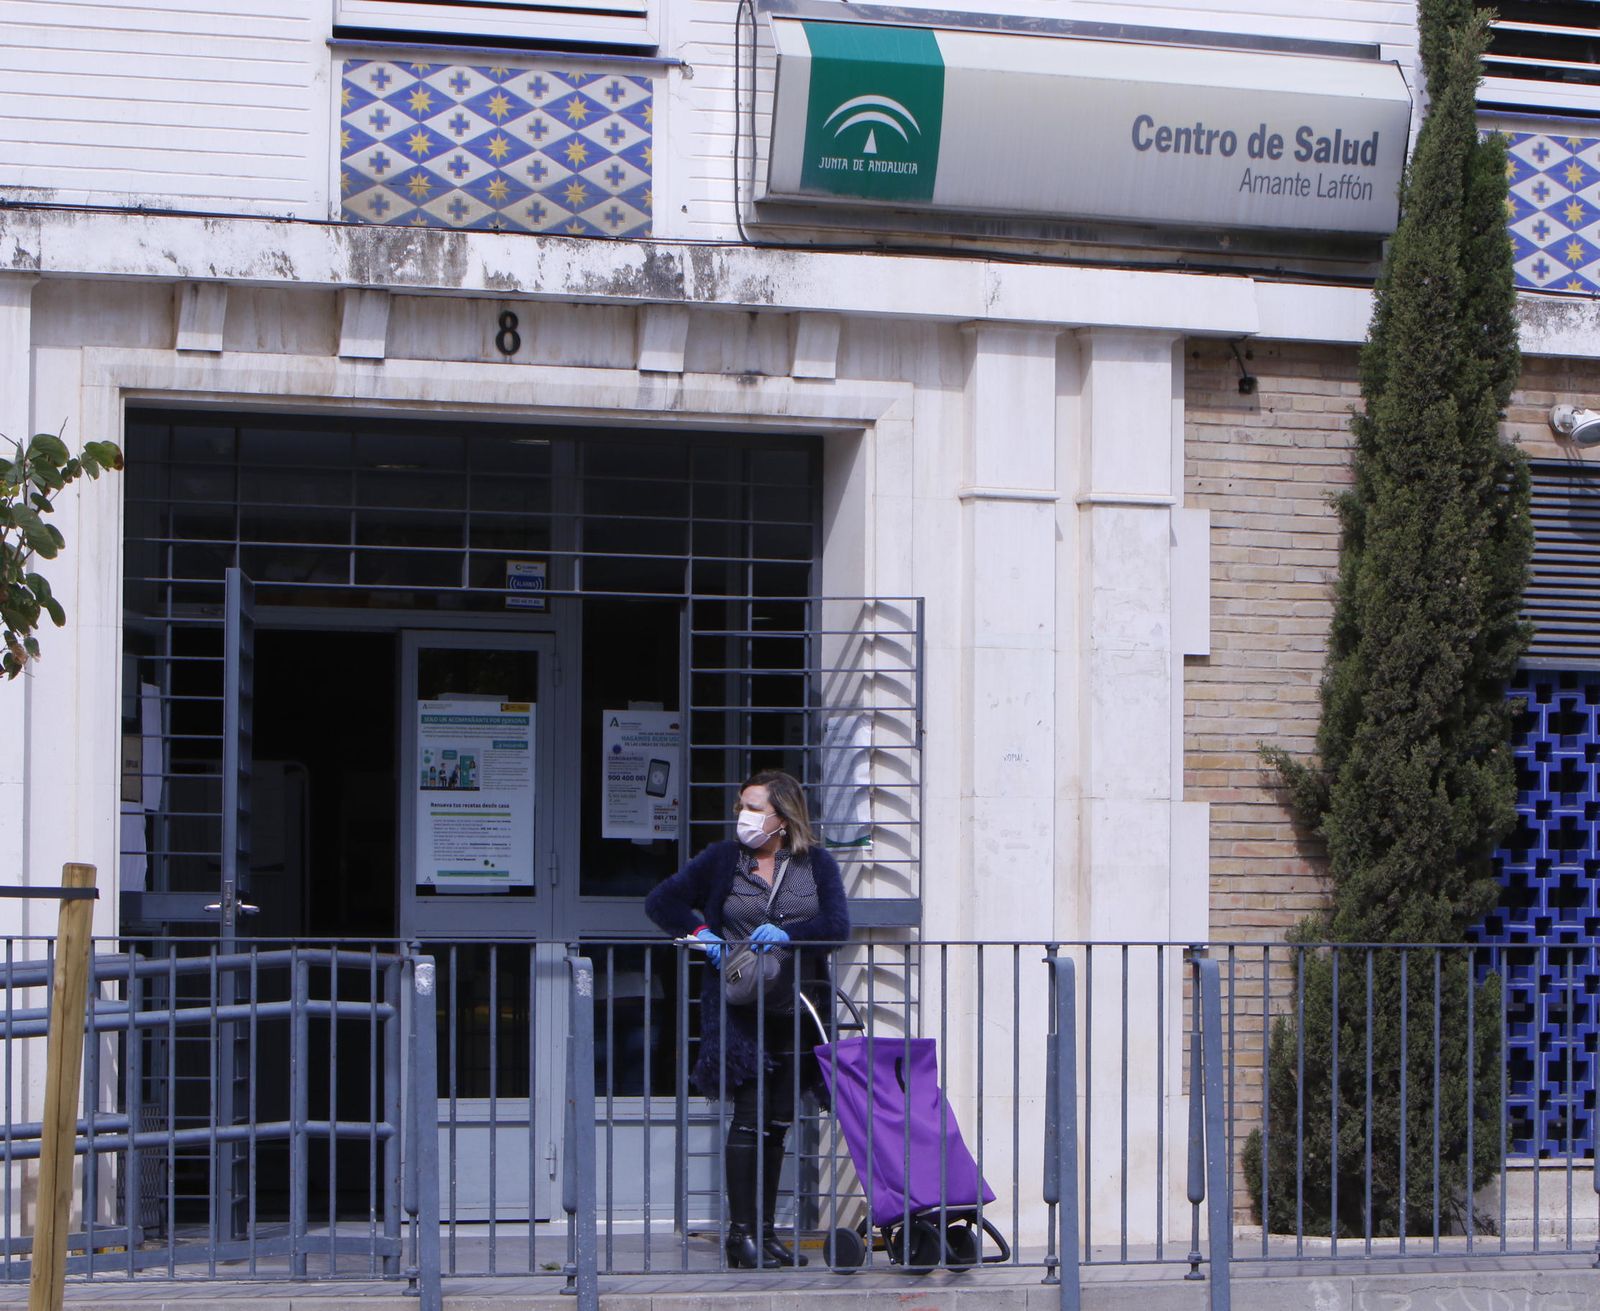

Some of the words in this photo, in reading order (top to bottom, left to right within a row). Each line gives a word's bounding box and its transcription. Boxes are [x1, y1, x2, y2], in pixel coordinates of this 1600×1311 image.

[1131, 114, 1237, 157] Centro
[1247, 123, 1284, 160] de
[1294, 125, 1379, 167] Salud
[818, 157, 848, 170] JUNTA
[853, 159, 864, 171] DE
[868, 160, 918, 175] ANDALUCIA
[1239, 167, 1310, 197] Amante
[1316, 173, 1373, 201] Laffón
[495, 310, 521, 355] 8
